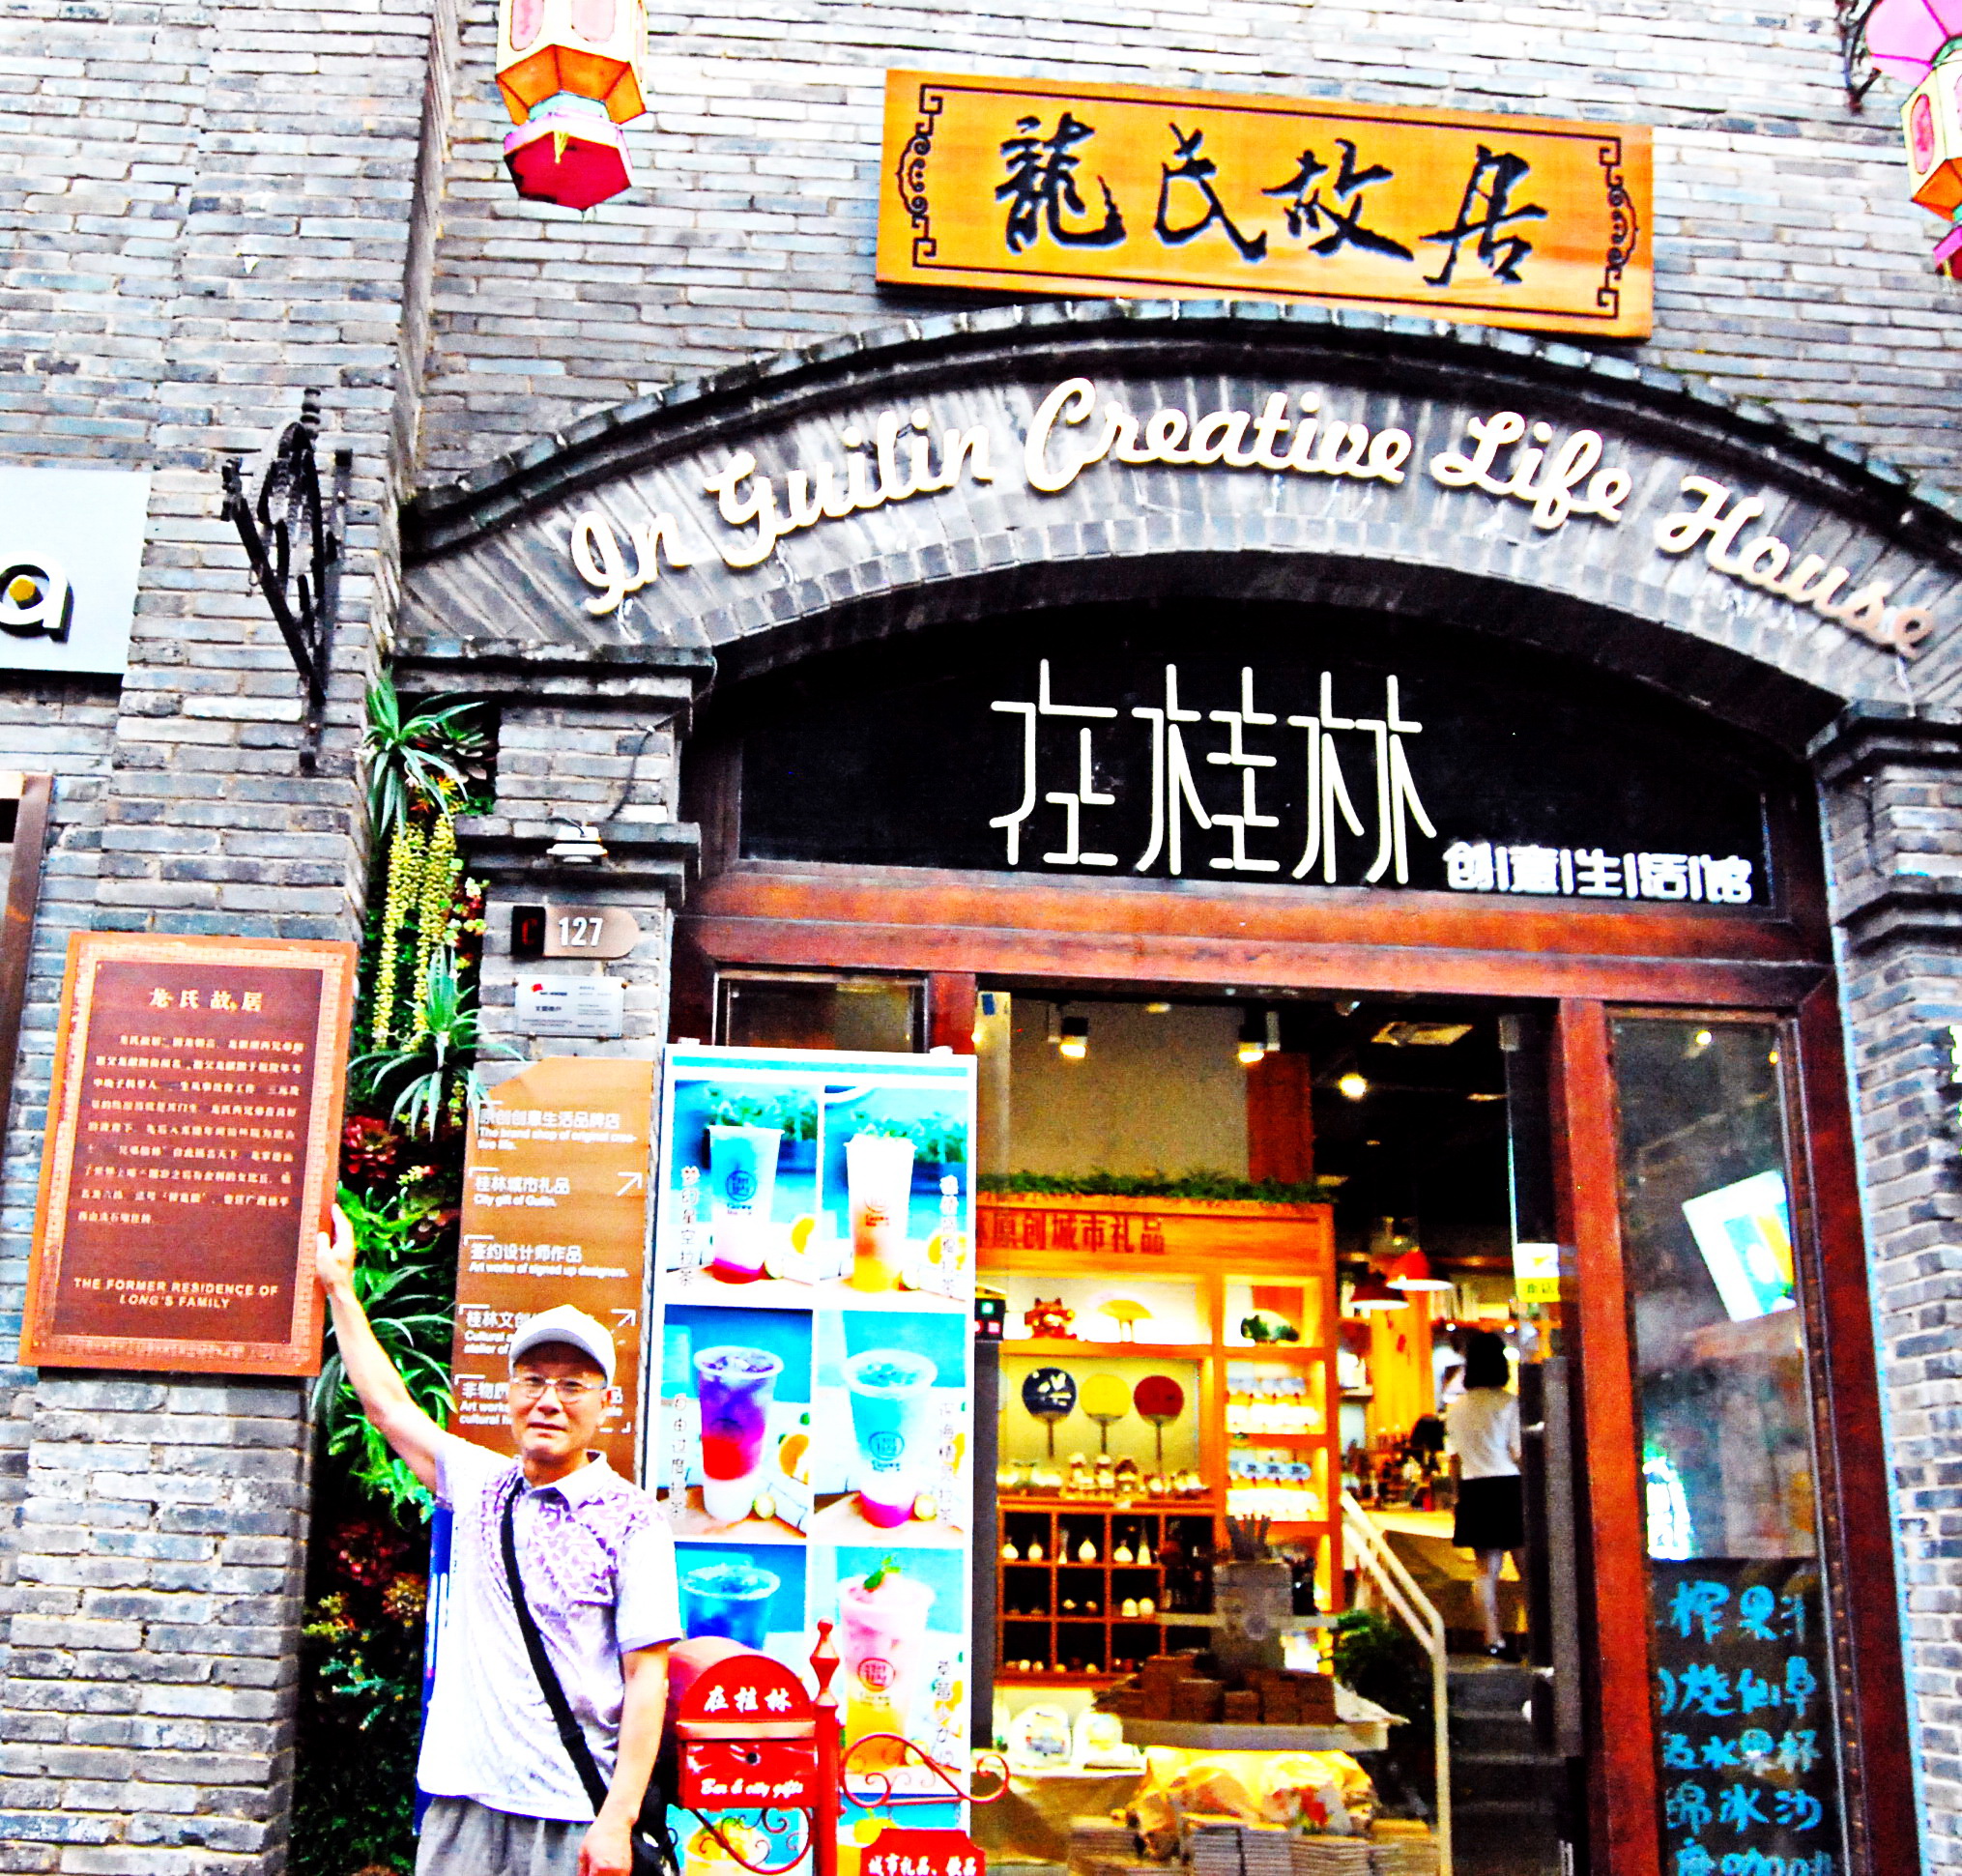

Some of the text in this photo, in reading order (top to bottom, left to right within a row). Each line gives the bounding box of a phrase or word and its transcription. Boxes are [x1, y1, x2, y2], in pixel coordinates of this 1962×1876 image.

[570, 377, 1933, 659] In Guilin Creative Life House
[990, 659, 1437, 883] 在桂林
[558, 917, 603, 947] 127
[149, 988, 263, 1012] 龙氏故居
[476, 1175, 570, 1195] 桂林城市礼品
[73, 1277, 278, 1296] THE FORMER RESIDENCE OF
[119, 1294, 231, 1309] LONG'S FAMILY
[460, 1400, 476, 1411] Art
[704, 1686, 793, 1713] 在桂林
